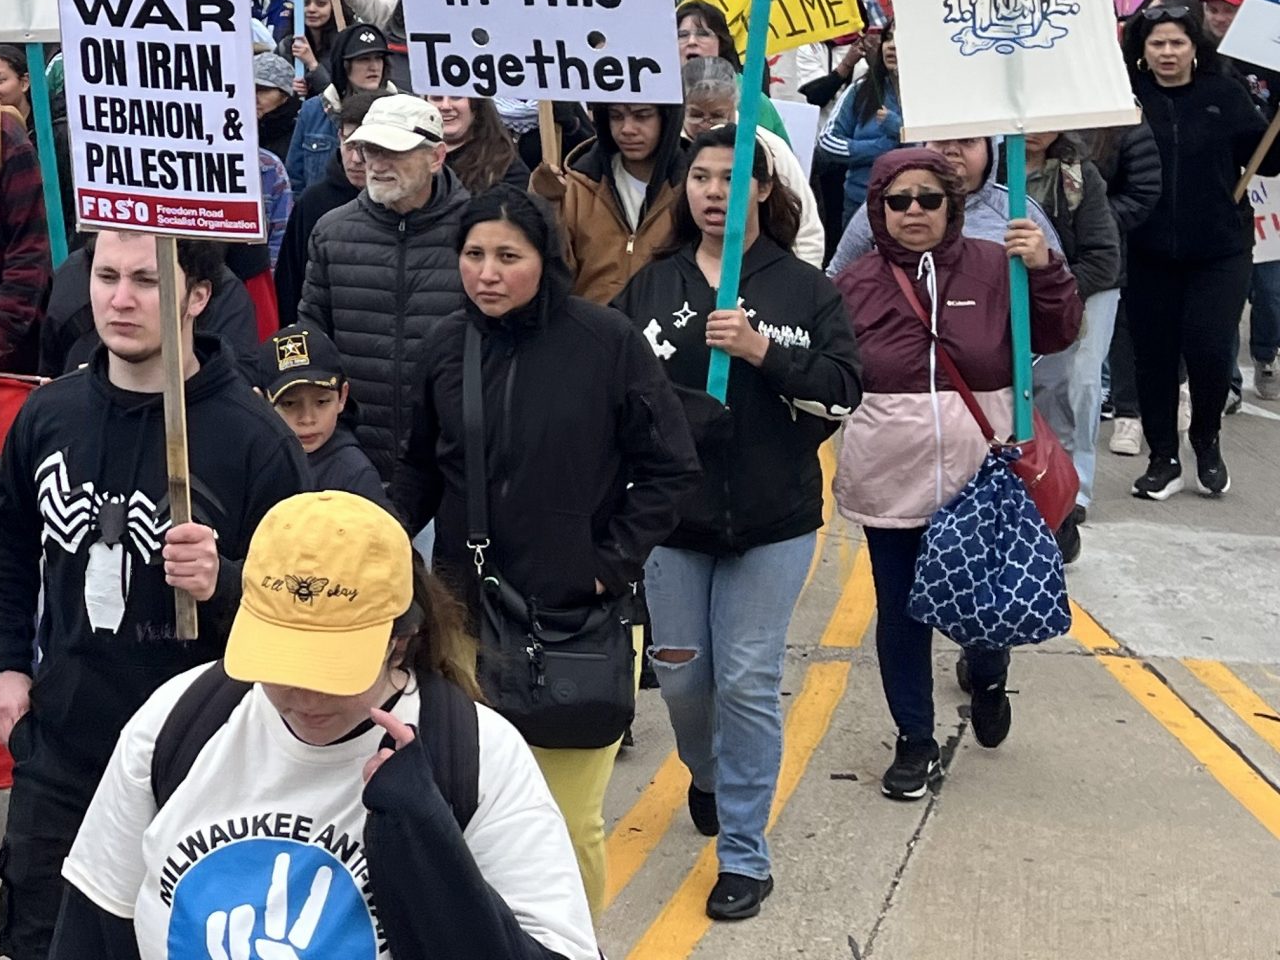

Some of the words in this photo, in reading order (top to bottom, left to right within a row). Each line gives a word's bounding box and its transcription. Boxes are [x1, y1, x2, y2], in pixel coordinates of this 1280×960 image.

[80, 37, 128, 87] ON
[136, 41, 236, 99] IRAN,
[410, 32, 662, 97] Together
[78, 94, 214, 146] LEBANON,
[223, 108, 245, 142] &
[85, 141, 248, 194] PALESTINE
[81, 195, 149, 223] FRSO
[156, 205, 198, 217] Freedom
[199, 208, 224, 218] Road
[156, 215, 196, 228] Socialist
[197, 217, 257, 230] Organization
[159, 812, 313, 908] MILWAUKEE
